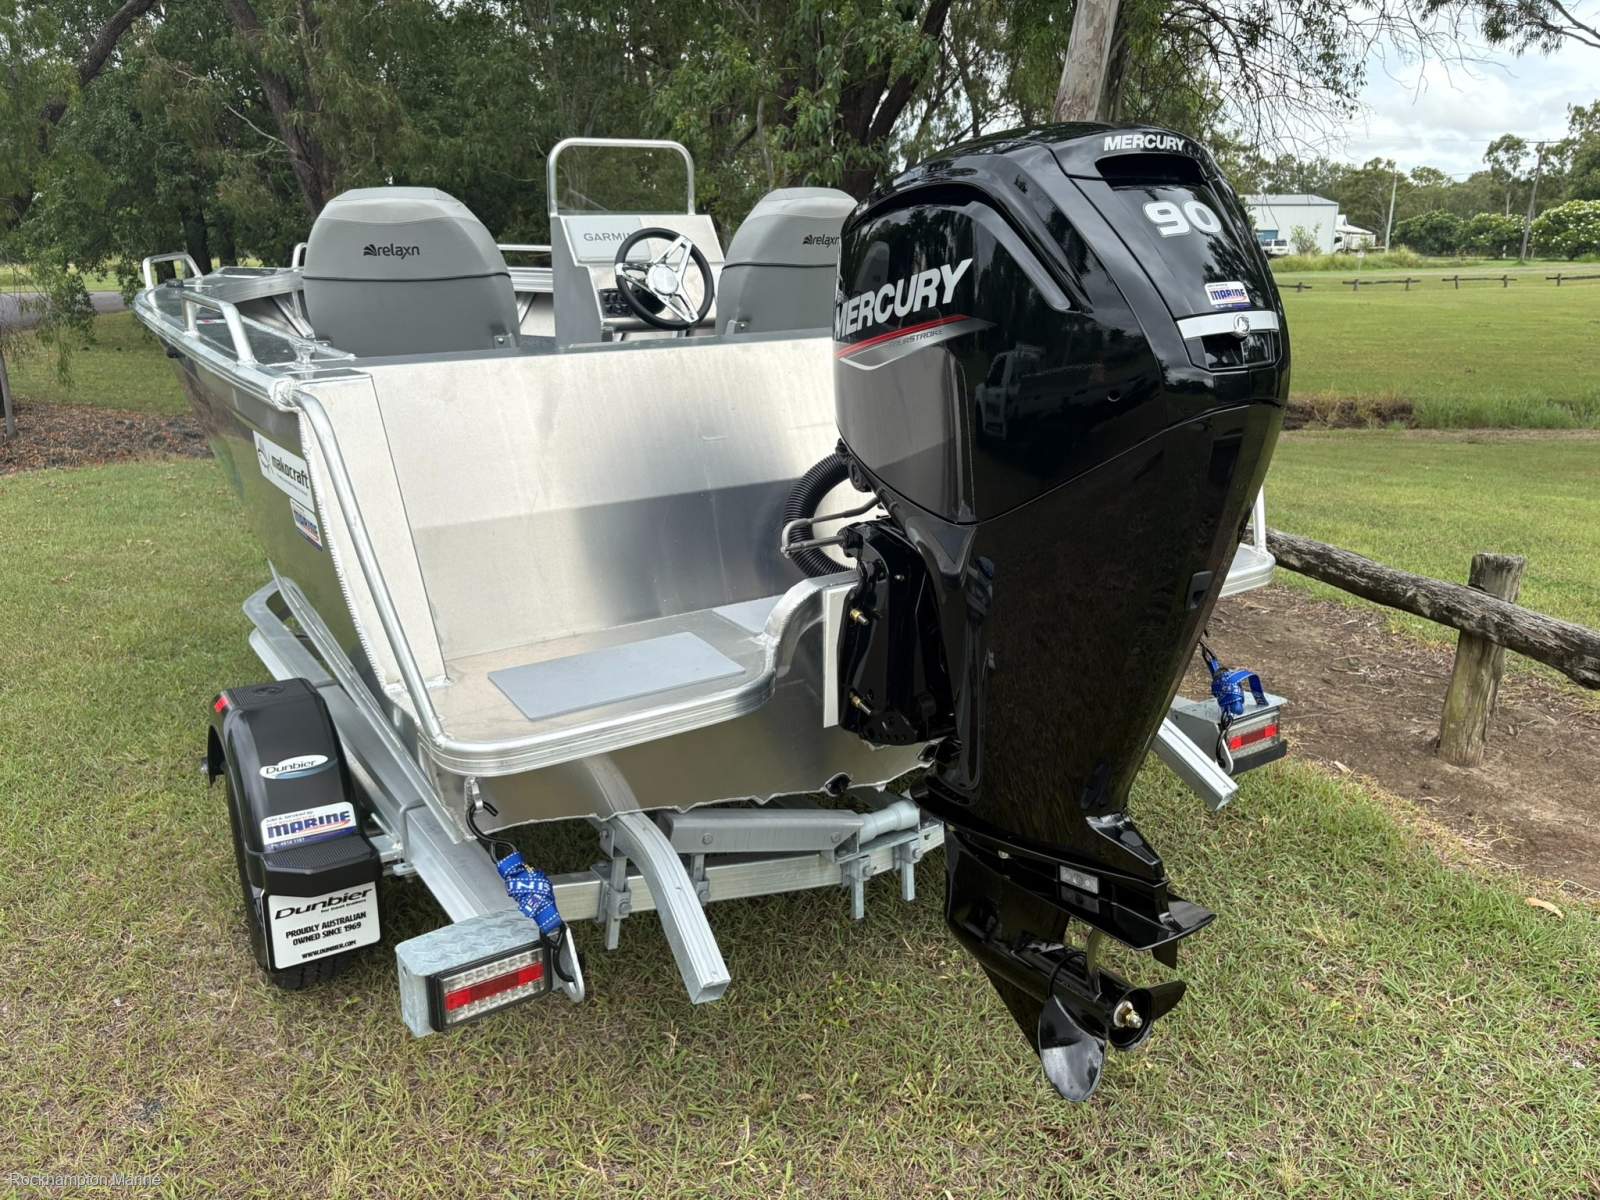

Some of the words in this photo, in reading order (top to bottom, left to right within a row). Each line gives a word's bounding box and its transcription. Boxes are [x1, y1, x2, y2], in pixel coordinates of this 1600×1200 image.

[1103, 134, 1185, 152] MERCURY
[1143, 201, 1221, 237] 90
[377, 243, 420, 260] relaxn
[834, 257, 973, 341] MERCURY
[271, 455, 310, 489] makocraft
[265, 760, 316, 775] Dunbier
[267, 810, 352, 839] MARINE
[274, 888, 373, 920] Dunbier
[285, 923, 320, 939] PROUDLY
[321, 911, 367, 930] AUSTRALIAN
[292, 933, 321, 946] OWNED
[322, 927, 343, 939] SINCE
[343, 921, 362, 933] 1969
